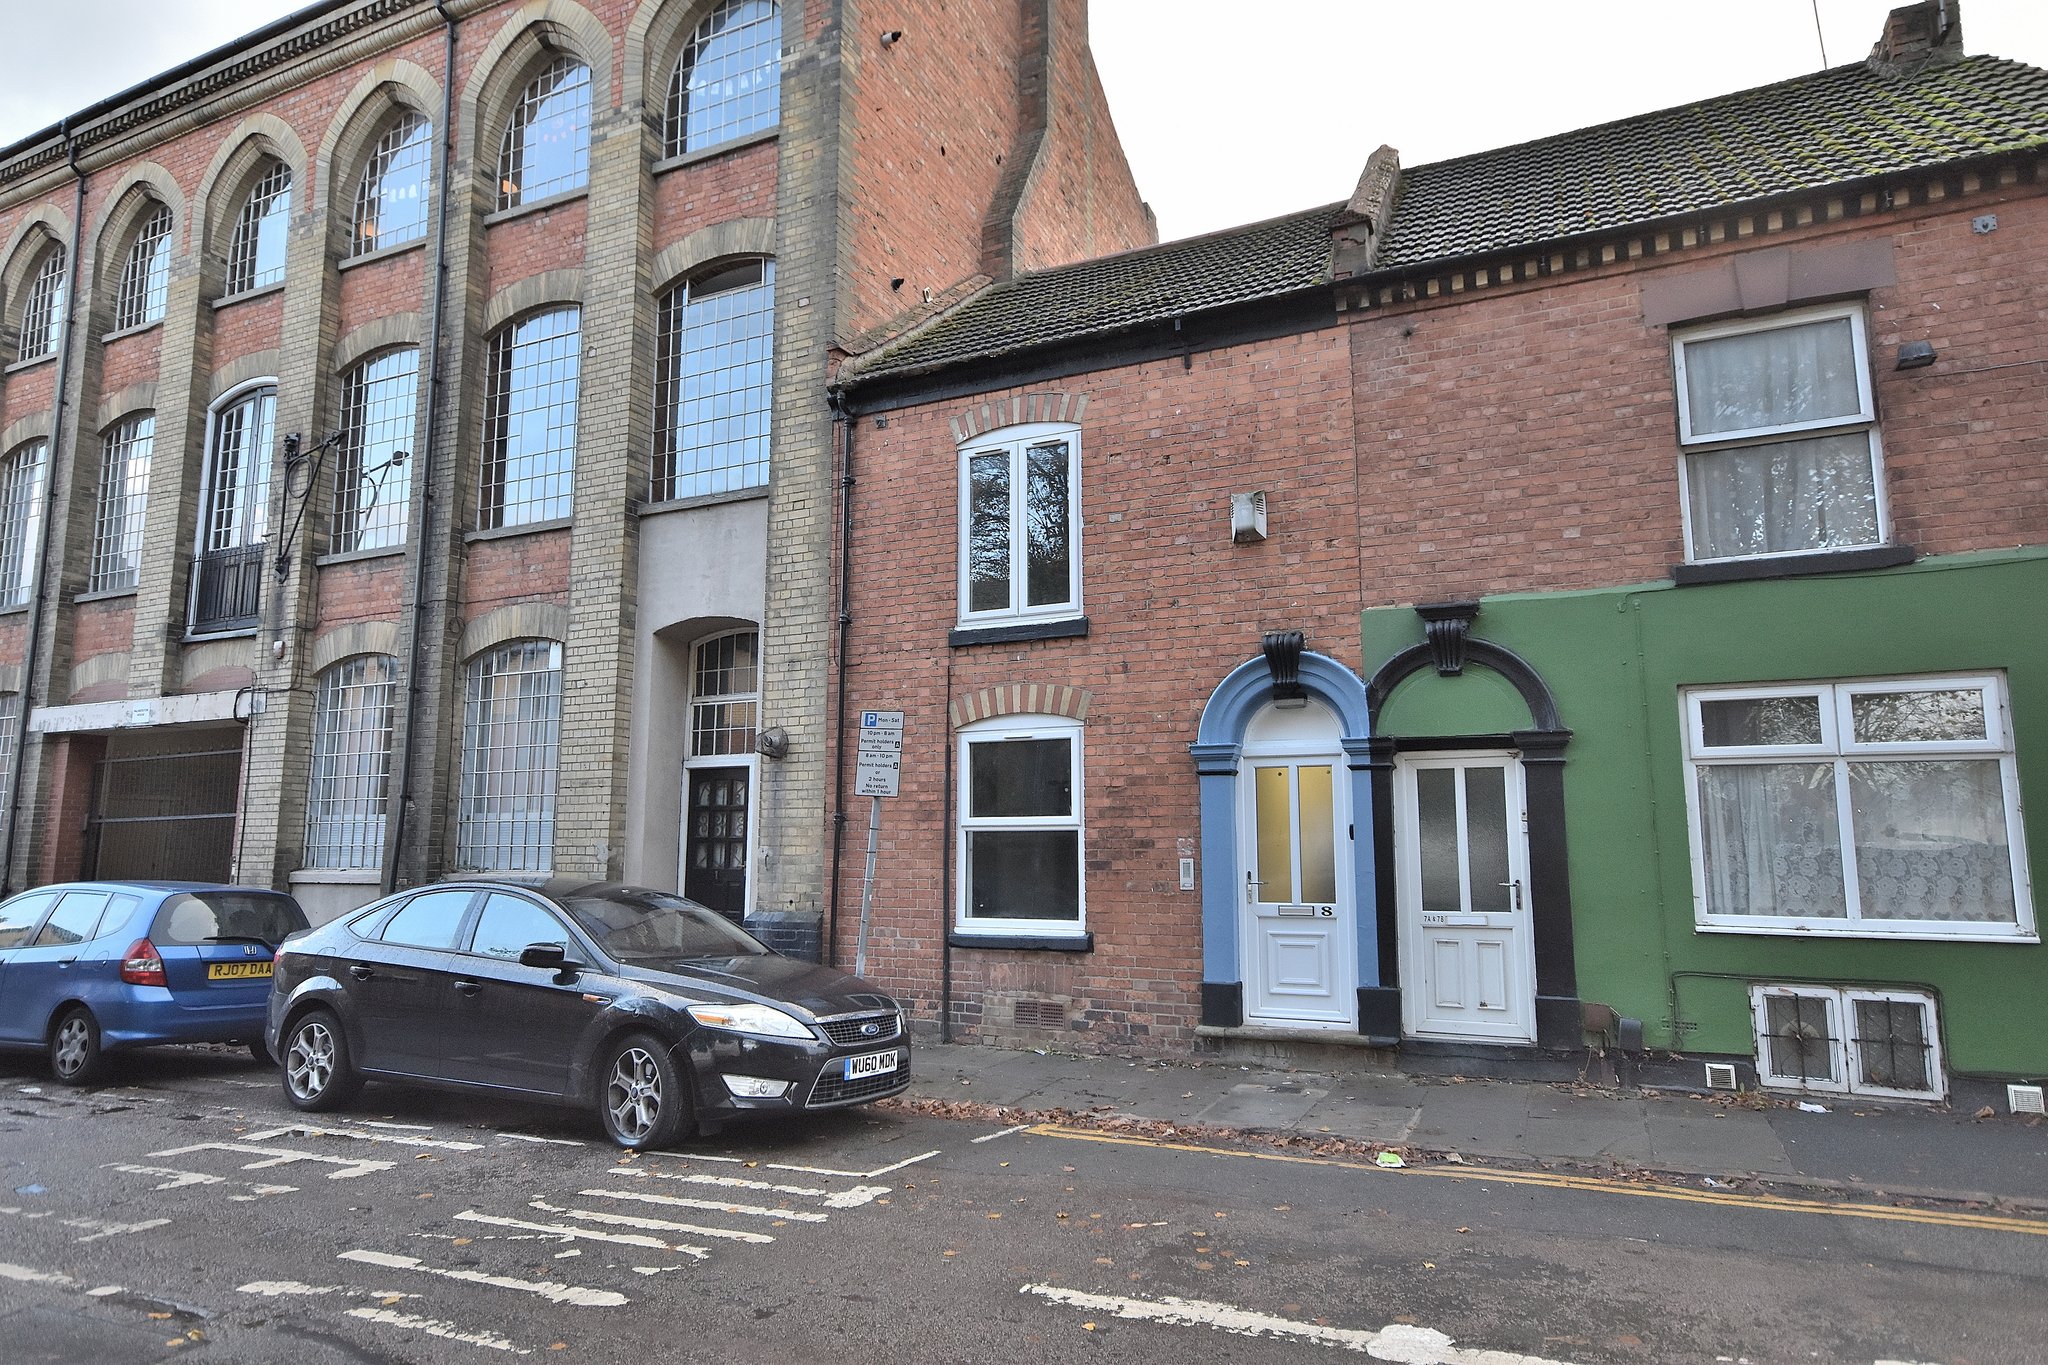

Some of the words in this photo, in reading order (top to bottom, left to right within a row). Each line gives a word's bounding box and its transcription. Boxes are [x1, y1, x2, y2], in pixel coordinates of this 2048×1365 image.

[867, 714, 875, 726] P
[1321, 906, 1332, 916] 8
[214, 964, 247, 976] RJ07
[250, 964, 271, 974] DAA
[852, 1056, 877, 1074] WU60
[879, 1052, 896, 1069] MDK
